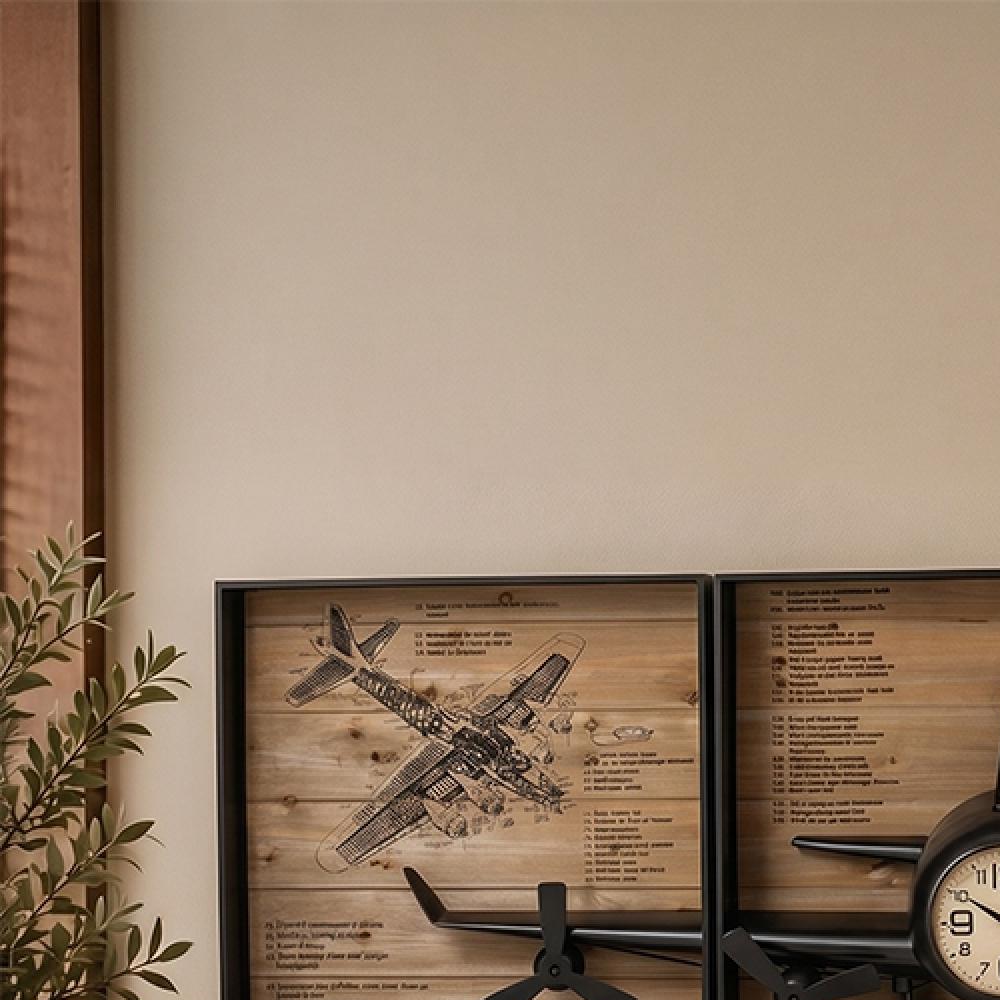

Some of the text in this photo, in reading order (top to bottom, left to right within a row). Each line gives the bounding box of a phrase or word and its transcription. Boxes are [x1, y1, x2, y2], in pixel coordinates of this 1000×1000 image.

[976, 869, 986, 884] 11
[950, 910, 973, 936] 9
[959, 942, 971, 956] 8
[978, 962, 990, 977] 7
